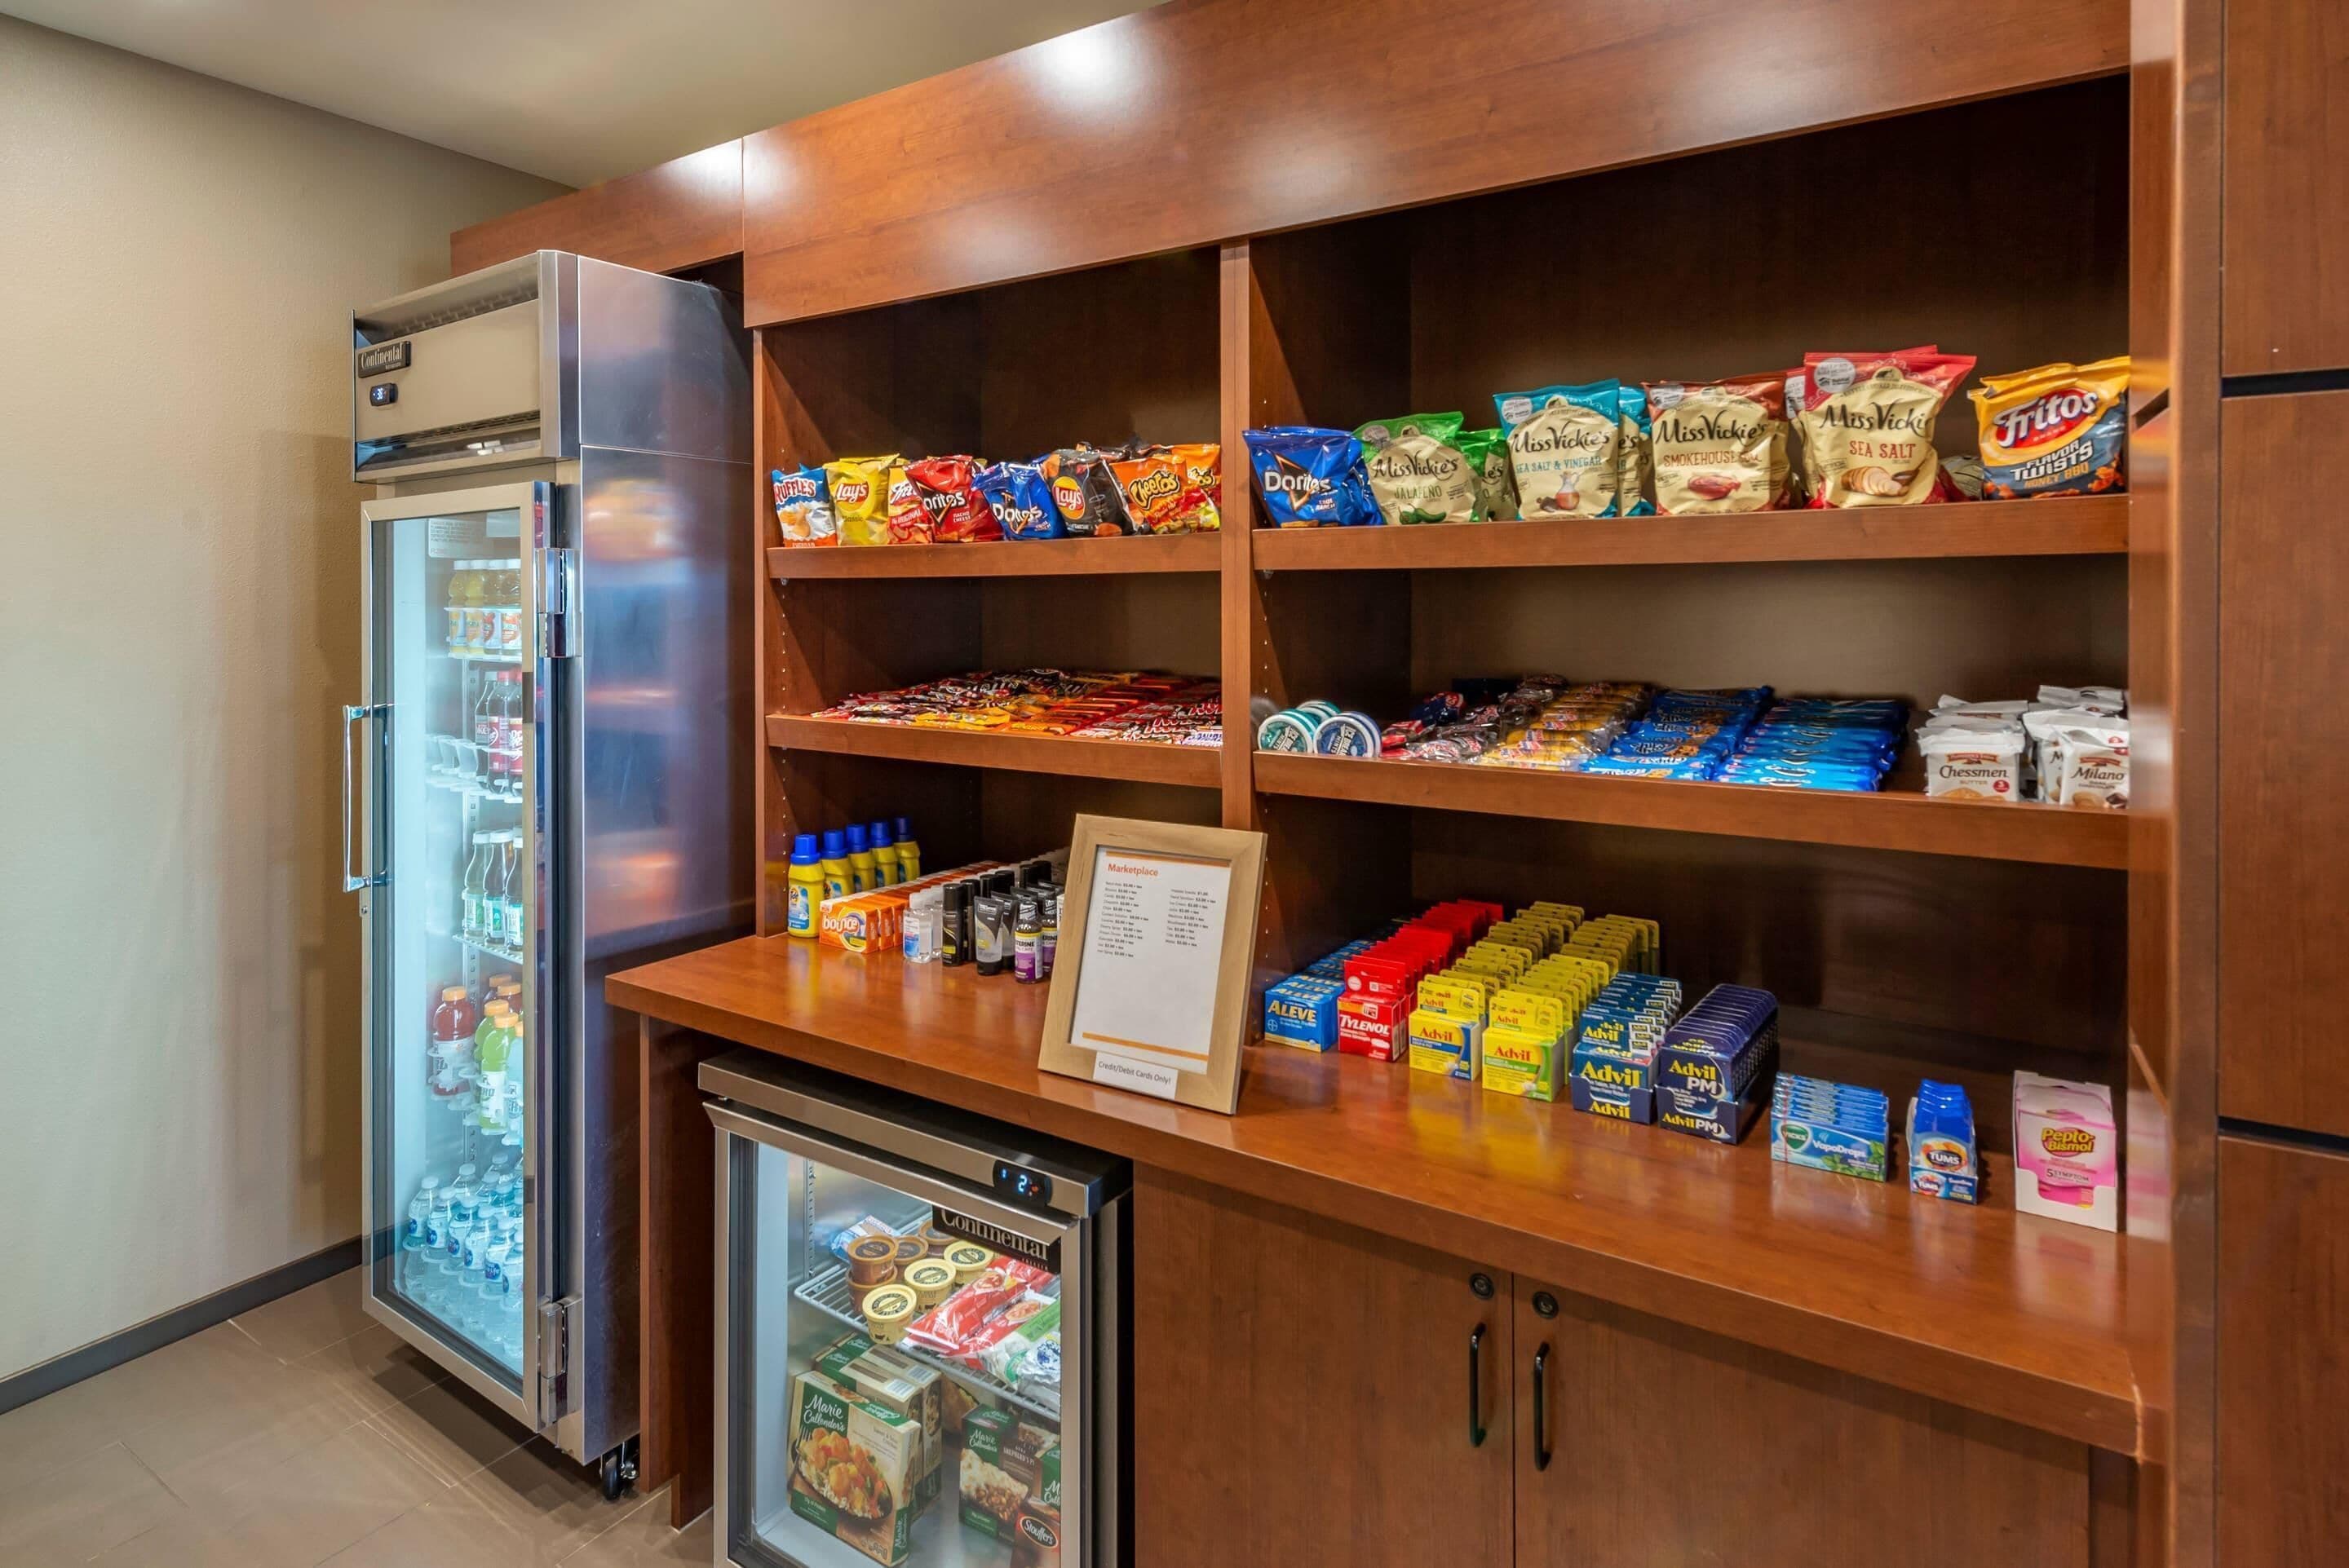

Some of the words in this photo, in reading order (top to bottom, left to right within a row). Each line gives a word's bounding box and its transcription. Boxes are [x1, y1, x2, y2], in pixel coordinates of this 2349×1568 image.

[361, 342, 403, 369] Continental
[1819, 404, 1874, 430] Miss
[1993, 392, 2099, 448] Fritos
[1511, 431, 1550, 453] Miss
[1548, 421, 1610, 451] Vickie's
[1655, 418, 1705, 444] Miss
[1700, 409, 1768, 447] Vickie's
[1663, 450, 1738, 467] SMOKEHOUSE
[1849, 440, 1873, 458] SEA
[1878, 444, 1917, 459] SALT
[2026, 439, 2080, 469] FLAVOR
[1374, 456, 1411, 479] Miss
[1405, 450, 1459, 481] Vickie's
[1532, 461, 1551, 471] SALT
[1553, 460, 1562, 470] &
[1564, 455, 1603, 470] VINEGAR
[2010, 440, 2095, 481] TWISTS
[2064, 462, 2090, 479] BBQ
[773, 478, 816, 505] RUFFLES
[1129, 472, 1178, 508] Cheetos
[1264, 470, 1332, 495] Doritos
[837, 482, 868, 504] Lay's
[923, 492, 966, 510] oritos
[1055, 487, 1082, 510] Lay's
[1344, 724, 1356, 739] ICE
[1330, 735, 1342, 755] MINTS
[1940, 765, 2009, 779] Chessmen
[2070, 766, 2125, 780] Milano
[1108, 863, 1159, 877] Marketplace
[822, 913, 858, 933] bounce
[1267, 1000, 1318, 1023] ALEVE
[1424, 998, 1444, 1008] Advil
[1339, 1014, 1391, 1036] TYLENOL
[1497, 1015, 1519, 1025] Advil
[1419, 1027, 1453, 1041] Advil
[1583, 1026, 1619, 1042] Advil
[1494, 1045, 1532, 1062] Advil
[1098, 1061, 1135, 1076] Credit/Debit
[1135, 1070, 1153, 1080] Cards
[1153, 1074, 1171, 1085] Only!
[1579, 1060, 1642, 1089] Advil
[1669, 1059, 1716, 1080] Advil
[1687, 1076, 1718, 1094] PM
[1589, 1101, 1631, 1120] Advil
[1661, 1112, 1696, 1128] Advil
[1695, 1119, 1719, 1133] PM
[2042, 1127, 2095, 1146] Pepto-
[1812, 1140, 1867, 1159] VapoDrops
[2047, 1141, 2094, 1153] Bismol
[1930, 1151, 1960, 1165] TUMS
[804, 1394, 844, 1420] Marie
[803, 1409, 846, 1433] Callender's
[969, 1429, 997, 1445] Marie
[1024, 1518, 1054, 1546] Stouffer's
